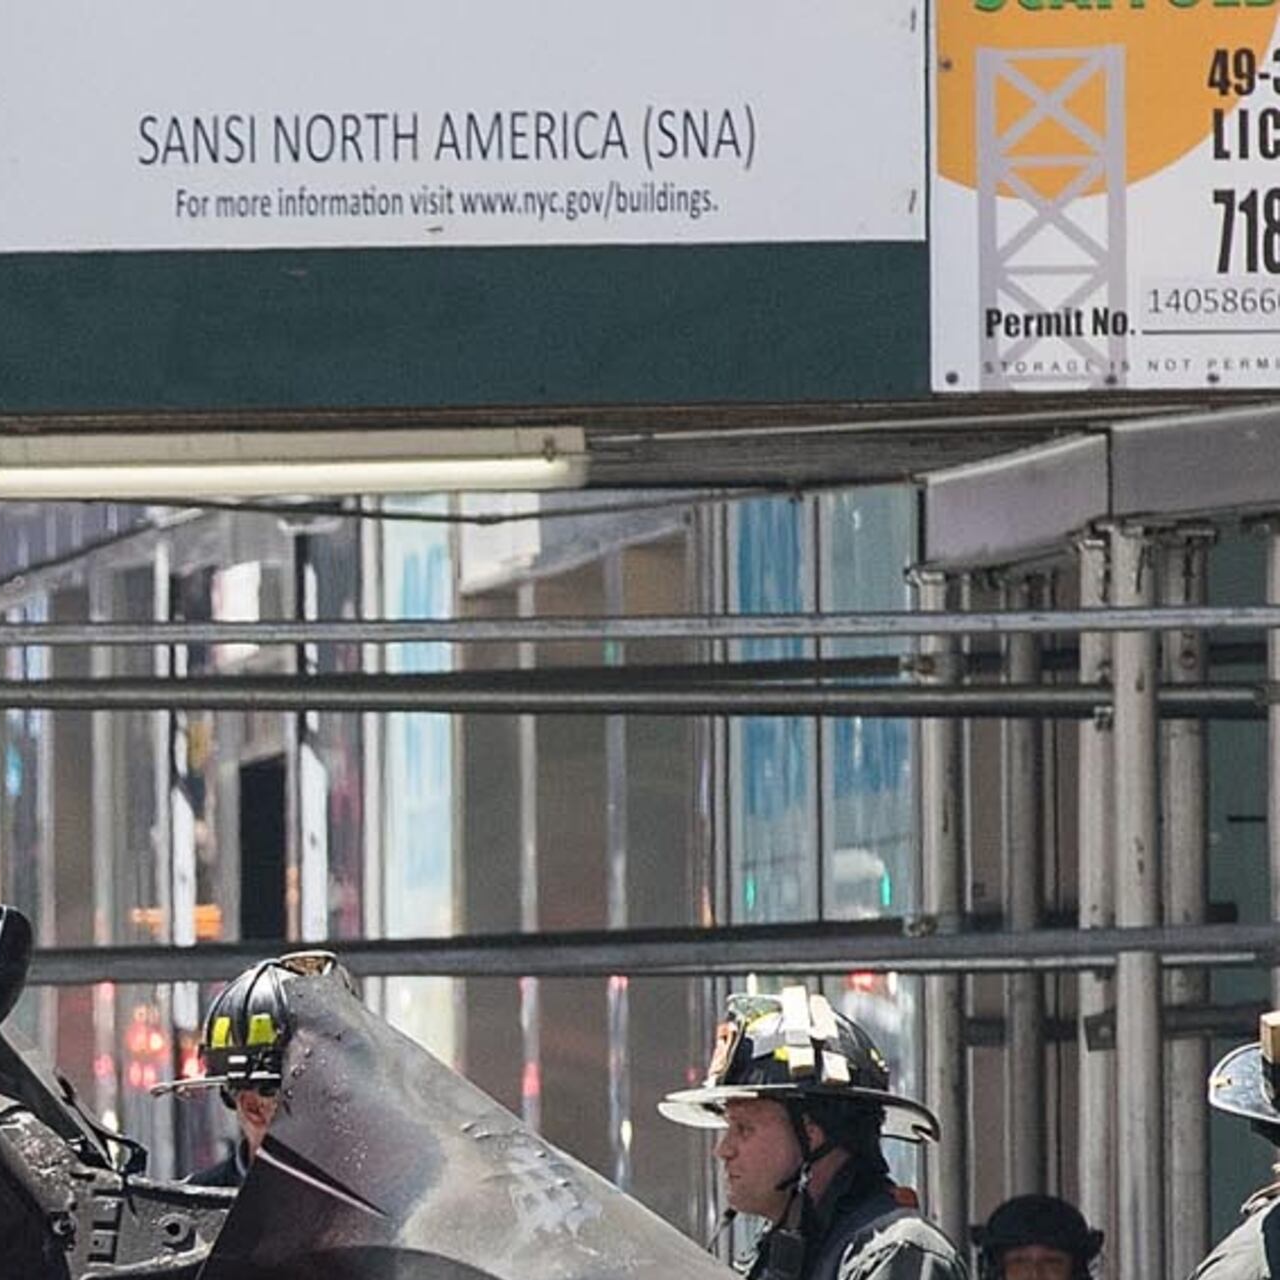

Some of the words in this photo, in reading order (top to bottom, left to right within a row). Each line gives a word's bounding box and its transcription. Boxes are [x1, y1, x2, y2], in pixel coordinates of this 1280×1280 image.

[138, 115, 257, 165] SANSI
[274, 113, 418, 163] NORTH
[434, 110, 628, 160] AMERICA
[643, 104, 756, 171] (SNA)
[176, 189, 209, 217] For
[215, 195, 272, 217] more
[278, 184, 404, 217] information
[410, 184, 455, 216] visit
[460, 180, 719, 221] www.nyc.gov/buildings.
[985, 307, 1084, 338] Permit
[1092, 307, 1136, 337] No.
[1148, 288, 1280, 314] 1405866
[984, 358, 1092, 374] STORAGE
[1109, 358, 1130, 374] IS
[1148, 358, 1191, 373] NOT
